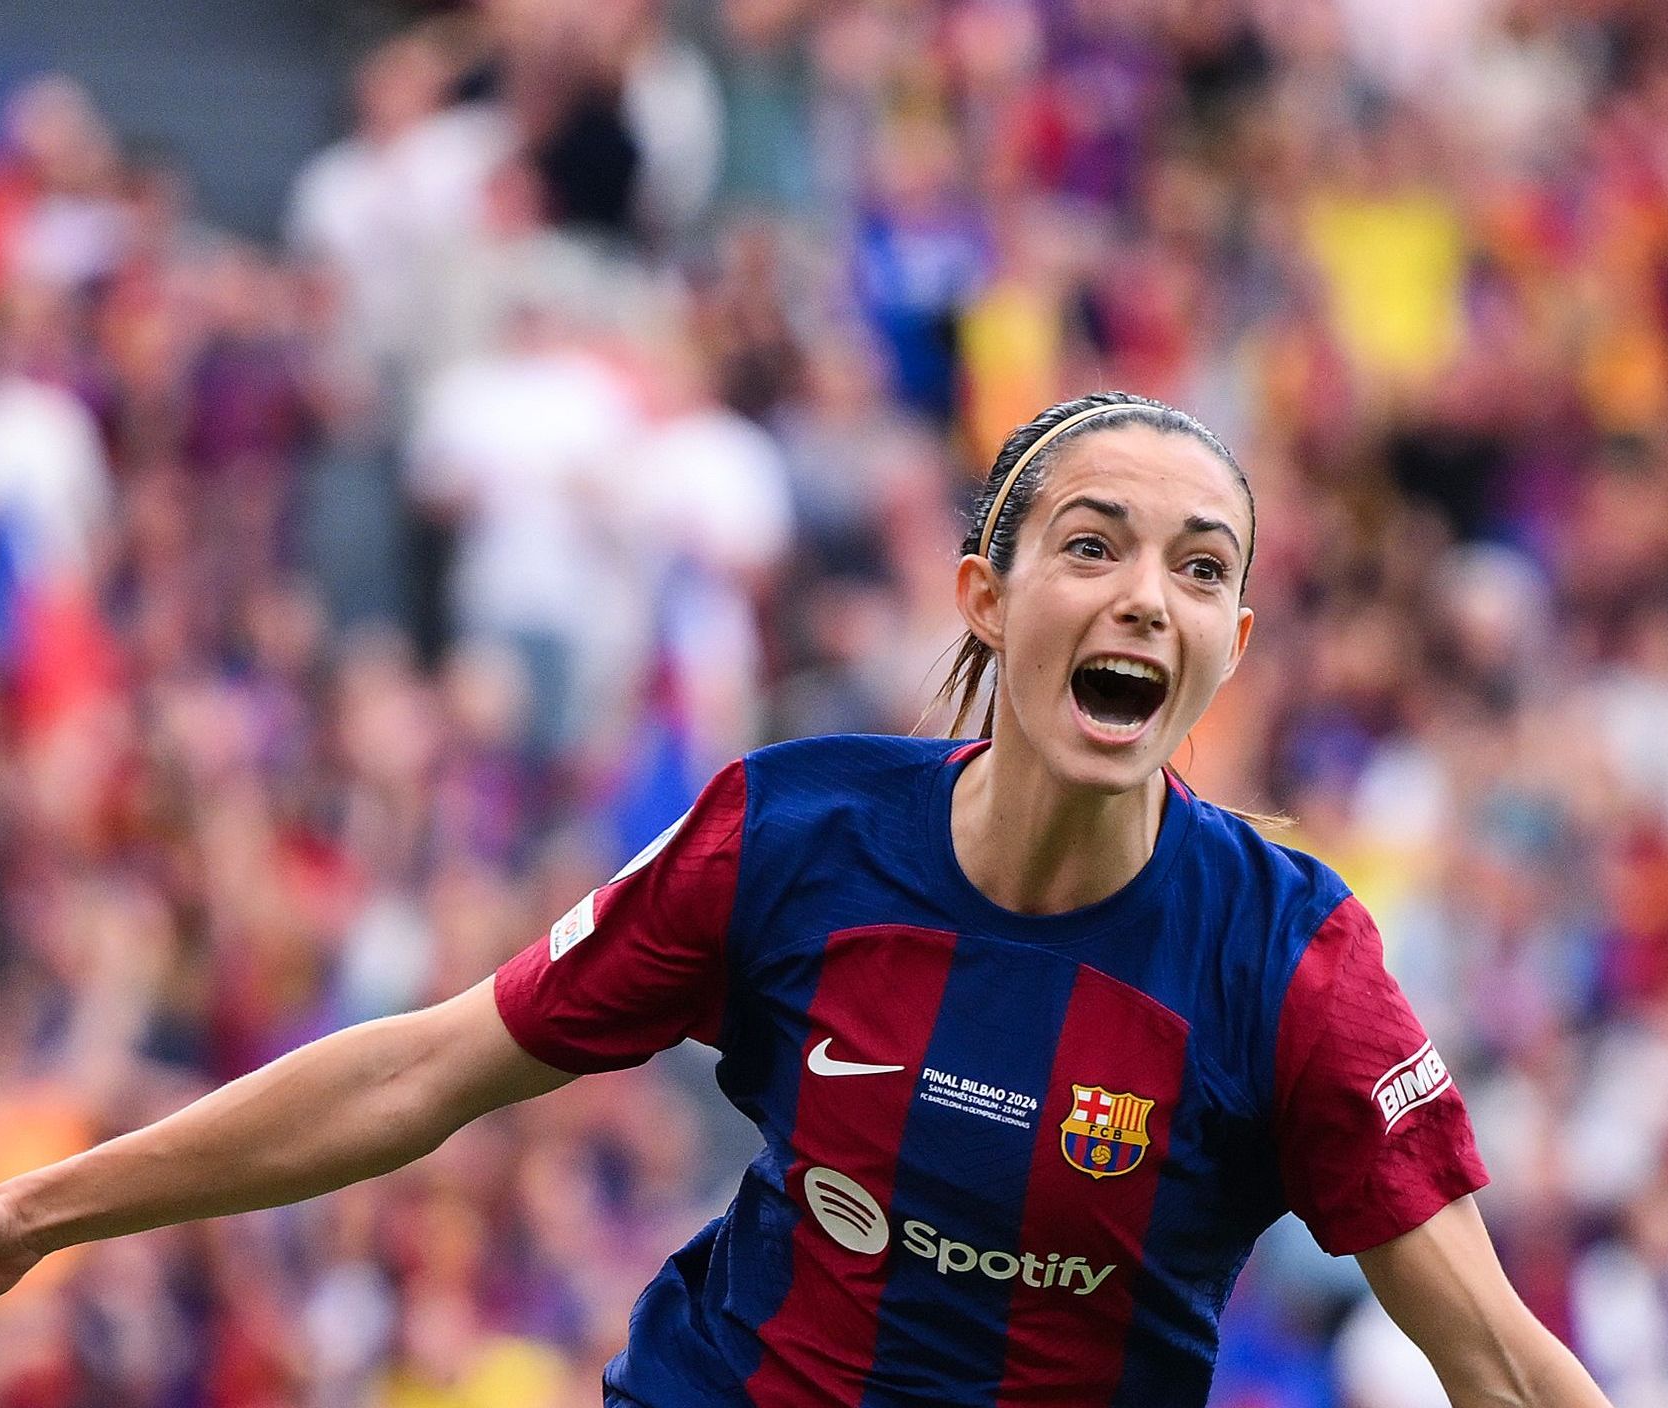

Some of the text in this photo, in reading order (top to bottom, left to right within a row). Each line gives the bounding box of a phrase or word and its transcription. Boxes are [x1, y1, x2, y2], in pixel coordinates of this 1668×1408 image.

[922, 1067, 1038, 1110] FINAL BILBAO 2024
[928, 1083, 944, 1094] SAN
[967, 1095, 999, 1110] STADIUM
[1012, 1107, 1028, 1118] MAY
[1377, 1047, 1449, 1122] BIMB
[902, 1219, 1117, 1295] Spotify
